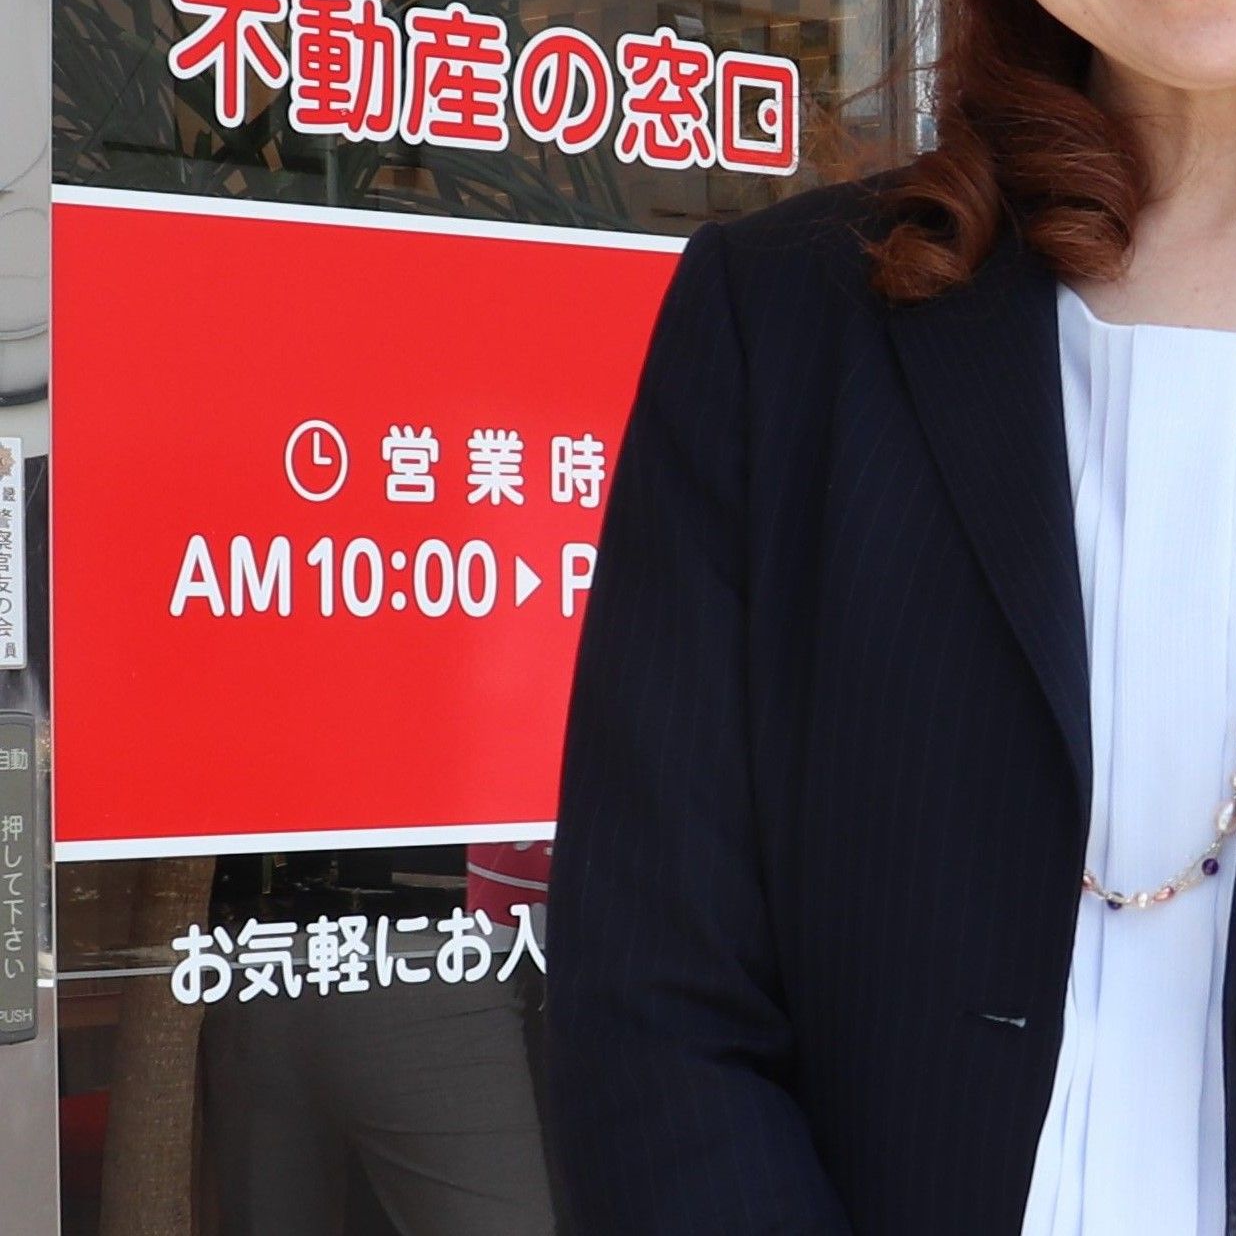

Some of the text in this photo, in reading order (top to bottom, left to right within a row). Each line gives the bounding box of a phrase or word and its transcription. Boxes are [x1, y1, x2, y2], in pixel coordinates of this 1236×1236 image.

[382, 423, 605, 508] 営業時
[2, 815, 24, 979] 押して下さい
[170, 903, 547, 1005] お気軽にお入
